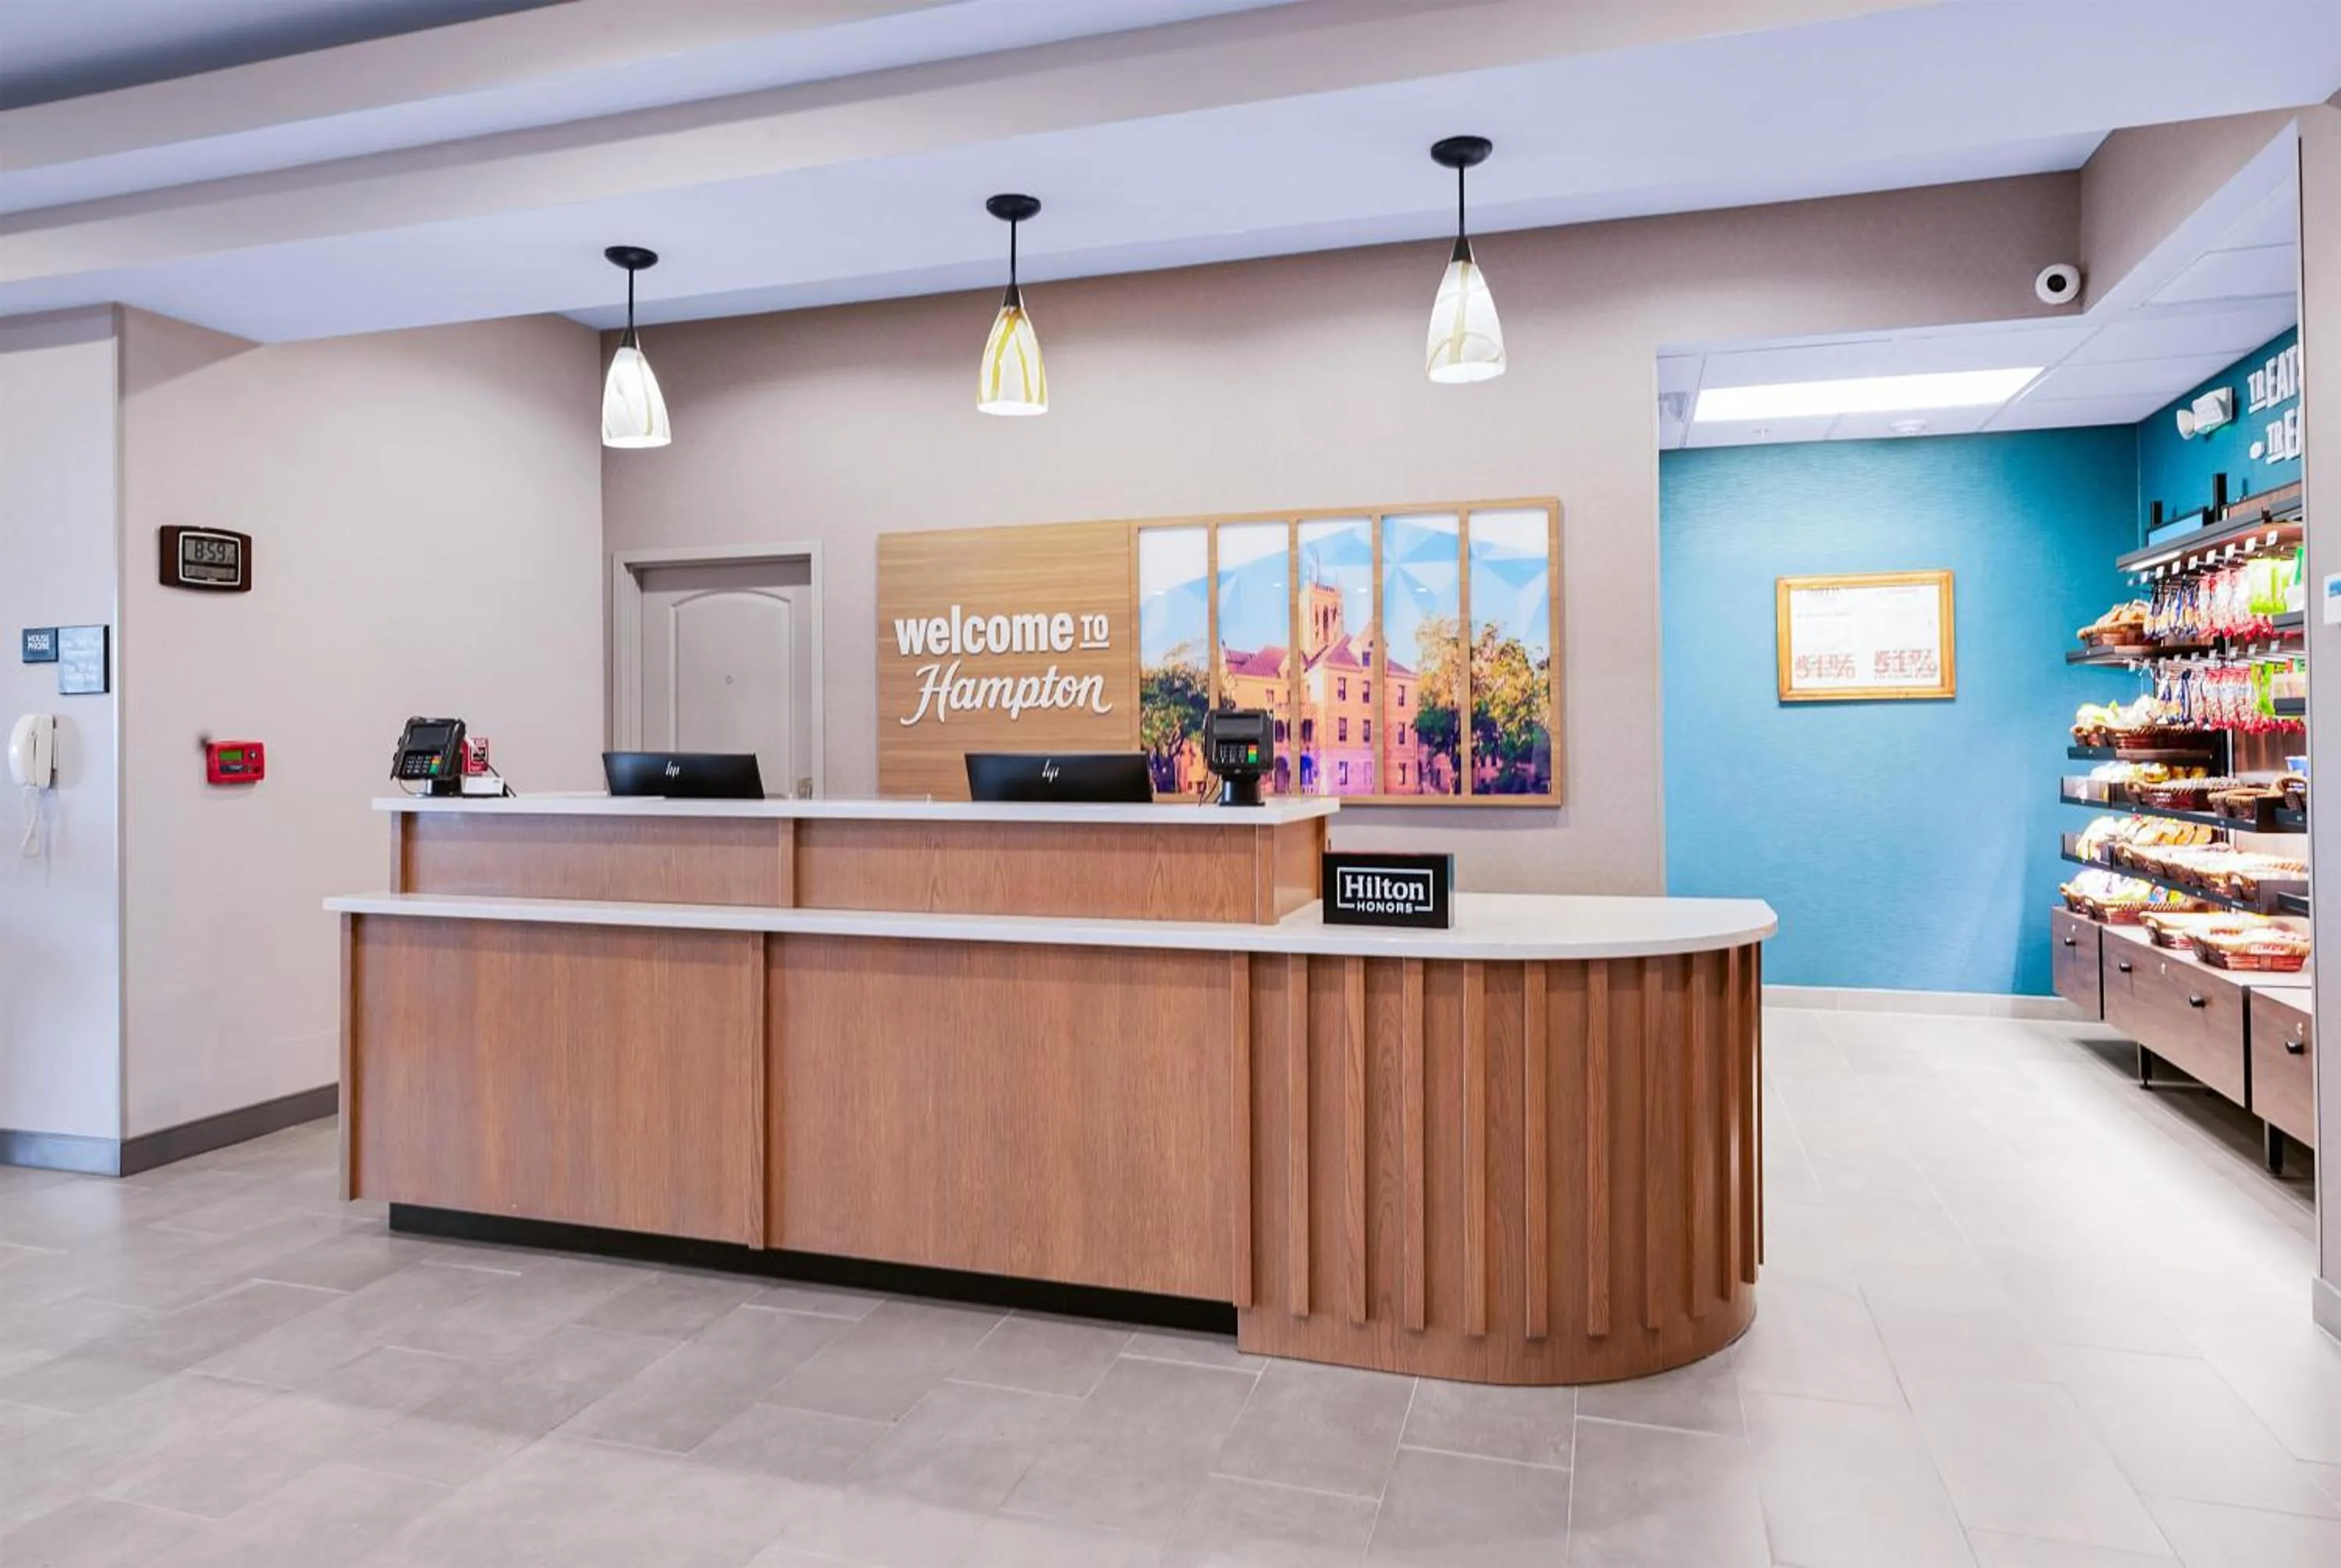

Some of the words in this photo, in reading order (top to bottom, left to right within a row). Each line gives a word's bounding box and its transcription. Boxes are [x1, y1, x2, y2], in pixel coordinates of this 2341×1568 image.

[194, 540, 226, 562] 8:59
[895, 605, 1075, 655] welcome
[1079, 613, 1110, 648] TO
[900, 659, 1113, 726] Hampton
[1345, 874, 1425, 901] Hilton
[1357, 901, 1413, 913] HONORS
